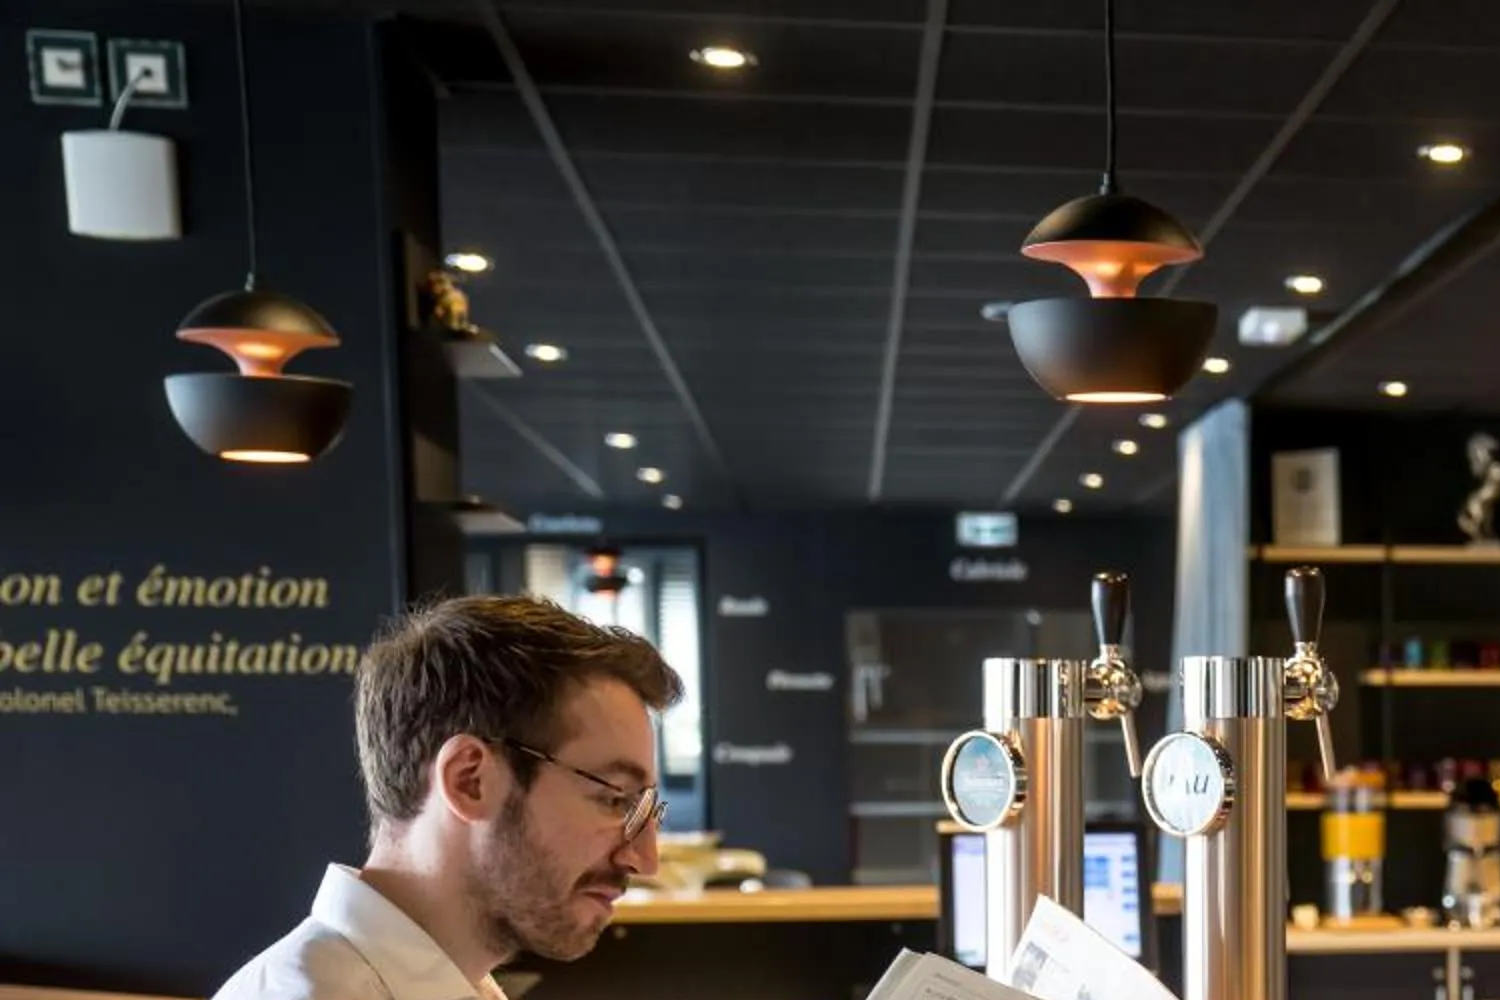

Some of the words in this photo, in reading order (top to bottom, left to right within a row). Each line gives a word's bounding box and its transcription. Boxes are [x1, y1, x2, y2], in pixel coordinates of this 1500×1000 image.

[0, 573, 60, 606] on
[77, 570, 123, 606] et
[136, 563, 330, 608] émotion
[118, 630, 357, 685] équitation
